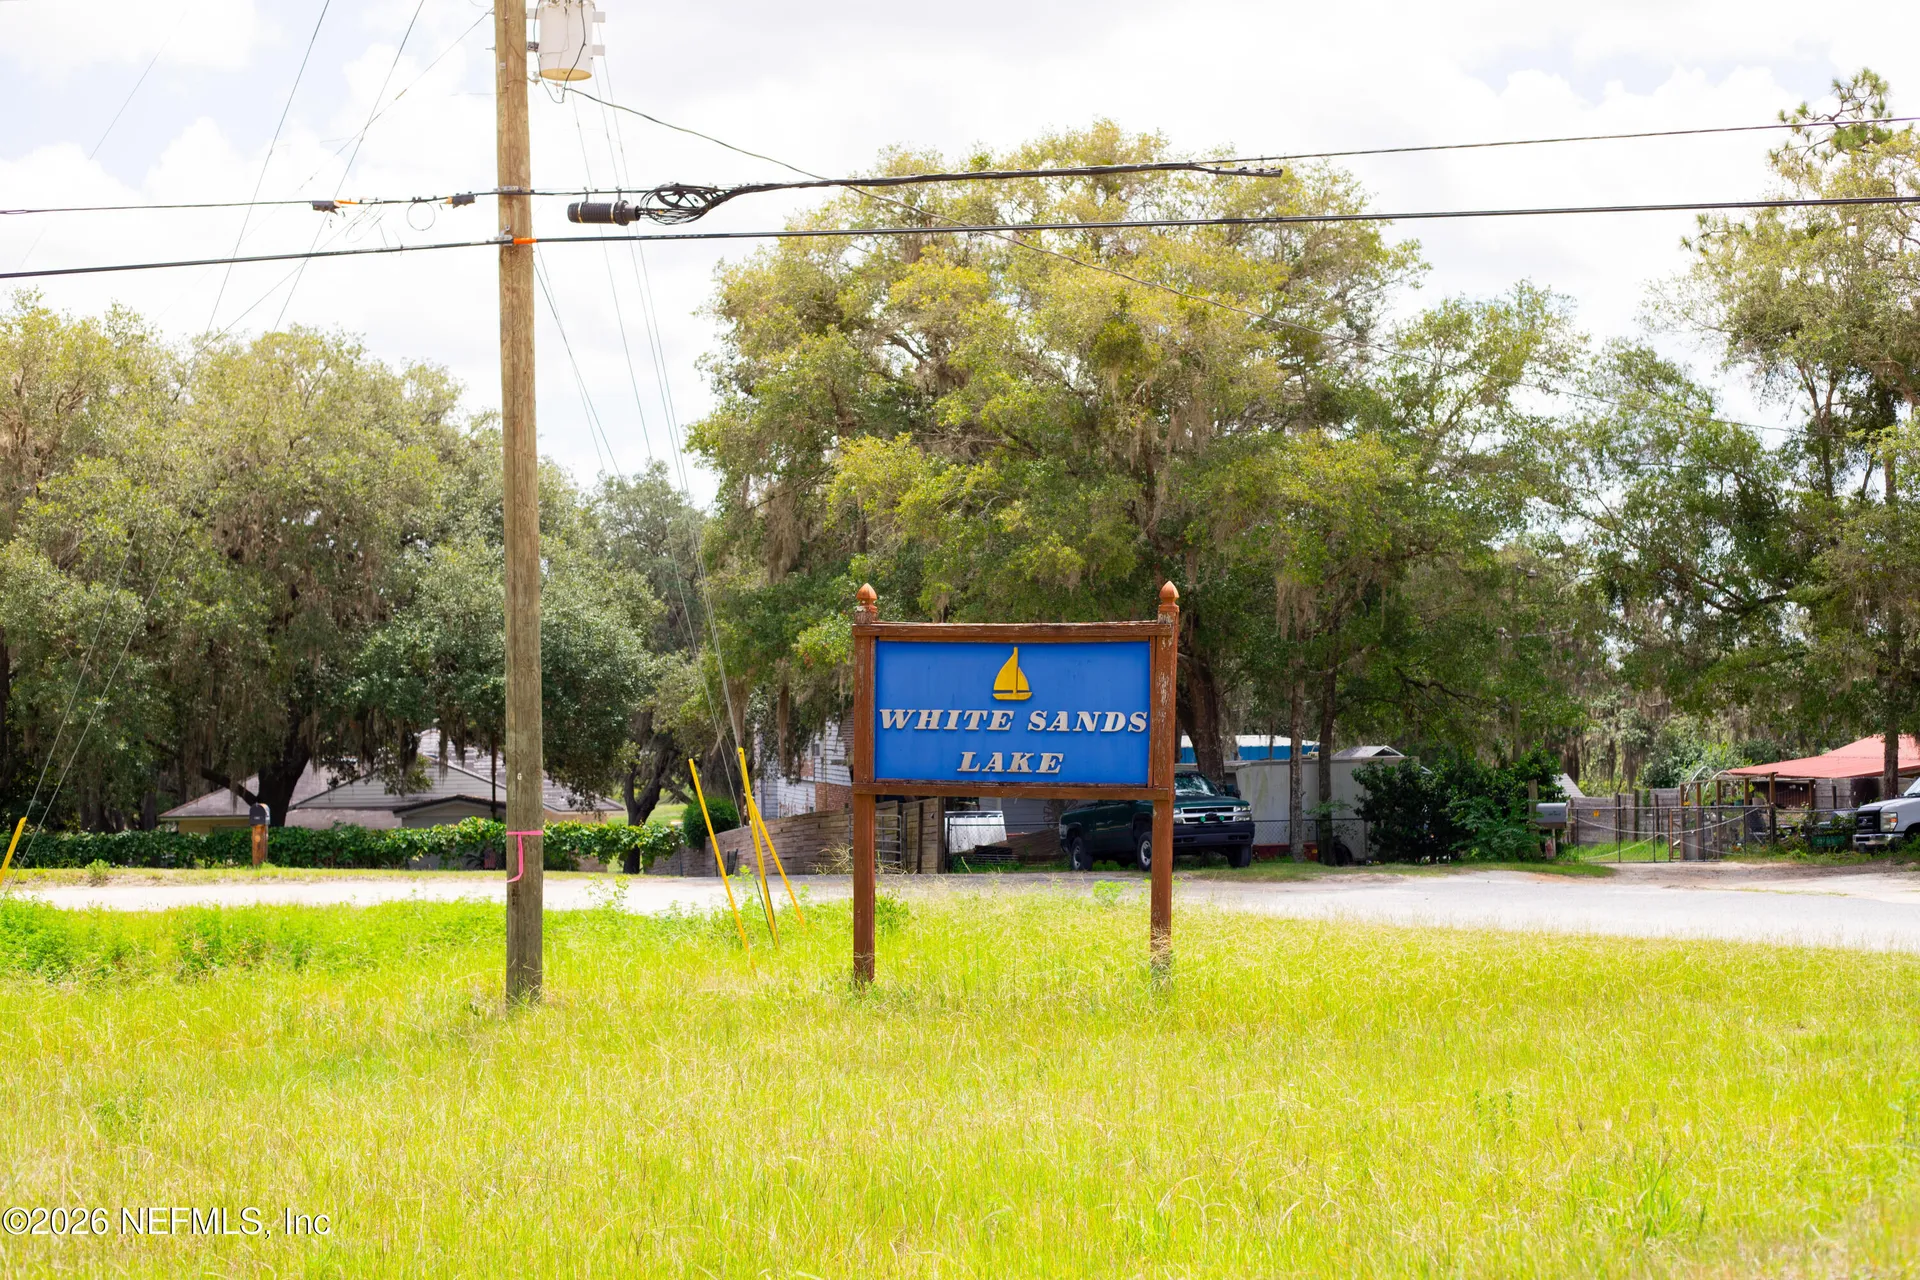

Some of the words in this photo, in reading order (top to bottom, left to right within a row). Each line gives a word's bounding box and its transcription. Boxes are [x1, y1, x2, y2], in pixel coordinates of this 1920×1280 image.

[879, 708, 1015, 731] WHITE
[1027, 710, 1148, 733] SANDS
[956, 751, 1064, 774] LAKE
